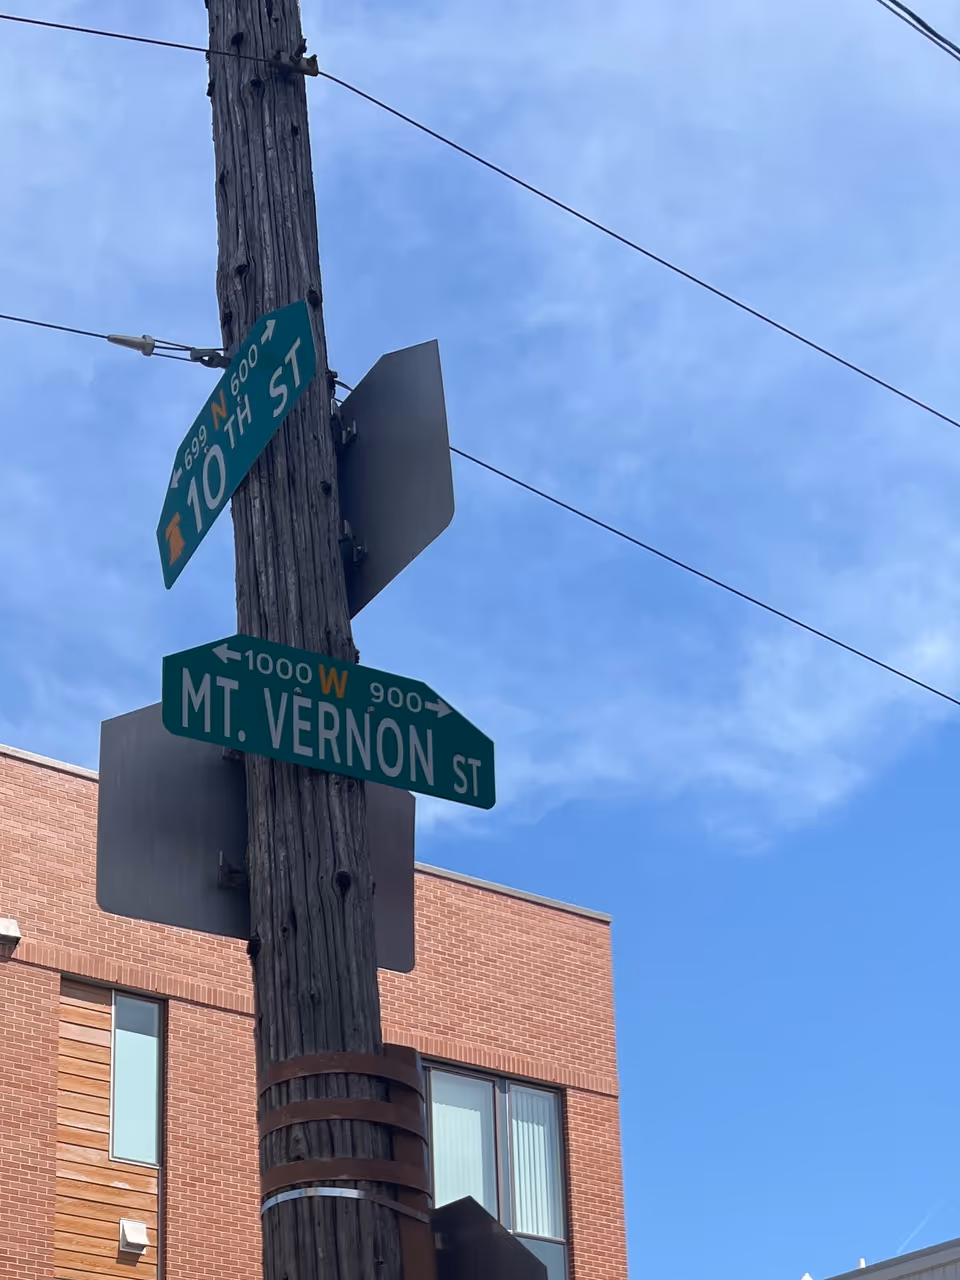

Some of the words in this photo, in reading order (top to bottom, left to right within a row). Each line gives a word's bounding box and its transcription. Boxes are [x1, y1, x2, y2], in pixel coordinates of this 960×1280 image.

[183, 423, 208, 471] 699
[210, 389, 228, 432] N
[230, 347, 259, 397] 600
[268, 337, 302, 419] ST
[181, 667, 247, 743] MT.
[263, 686, 435, 786] VERNON
[453, 753, 482, 798] ST
[244, 649, 313, 685] 1000
[318, 664, 348, 699] W
[369, 682, 423, 713] 900
